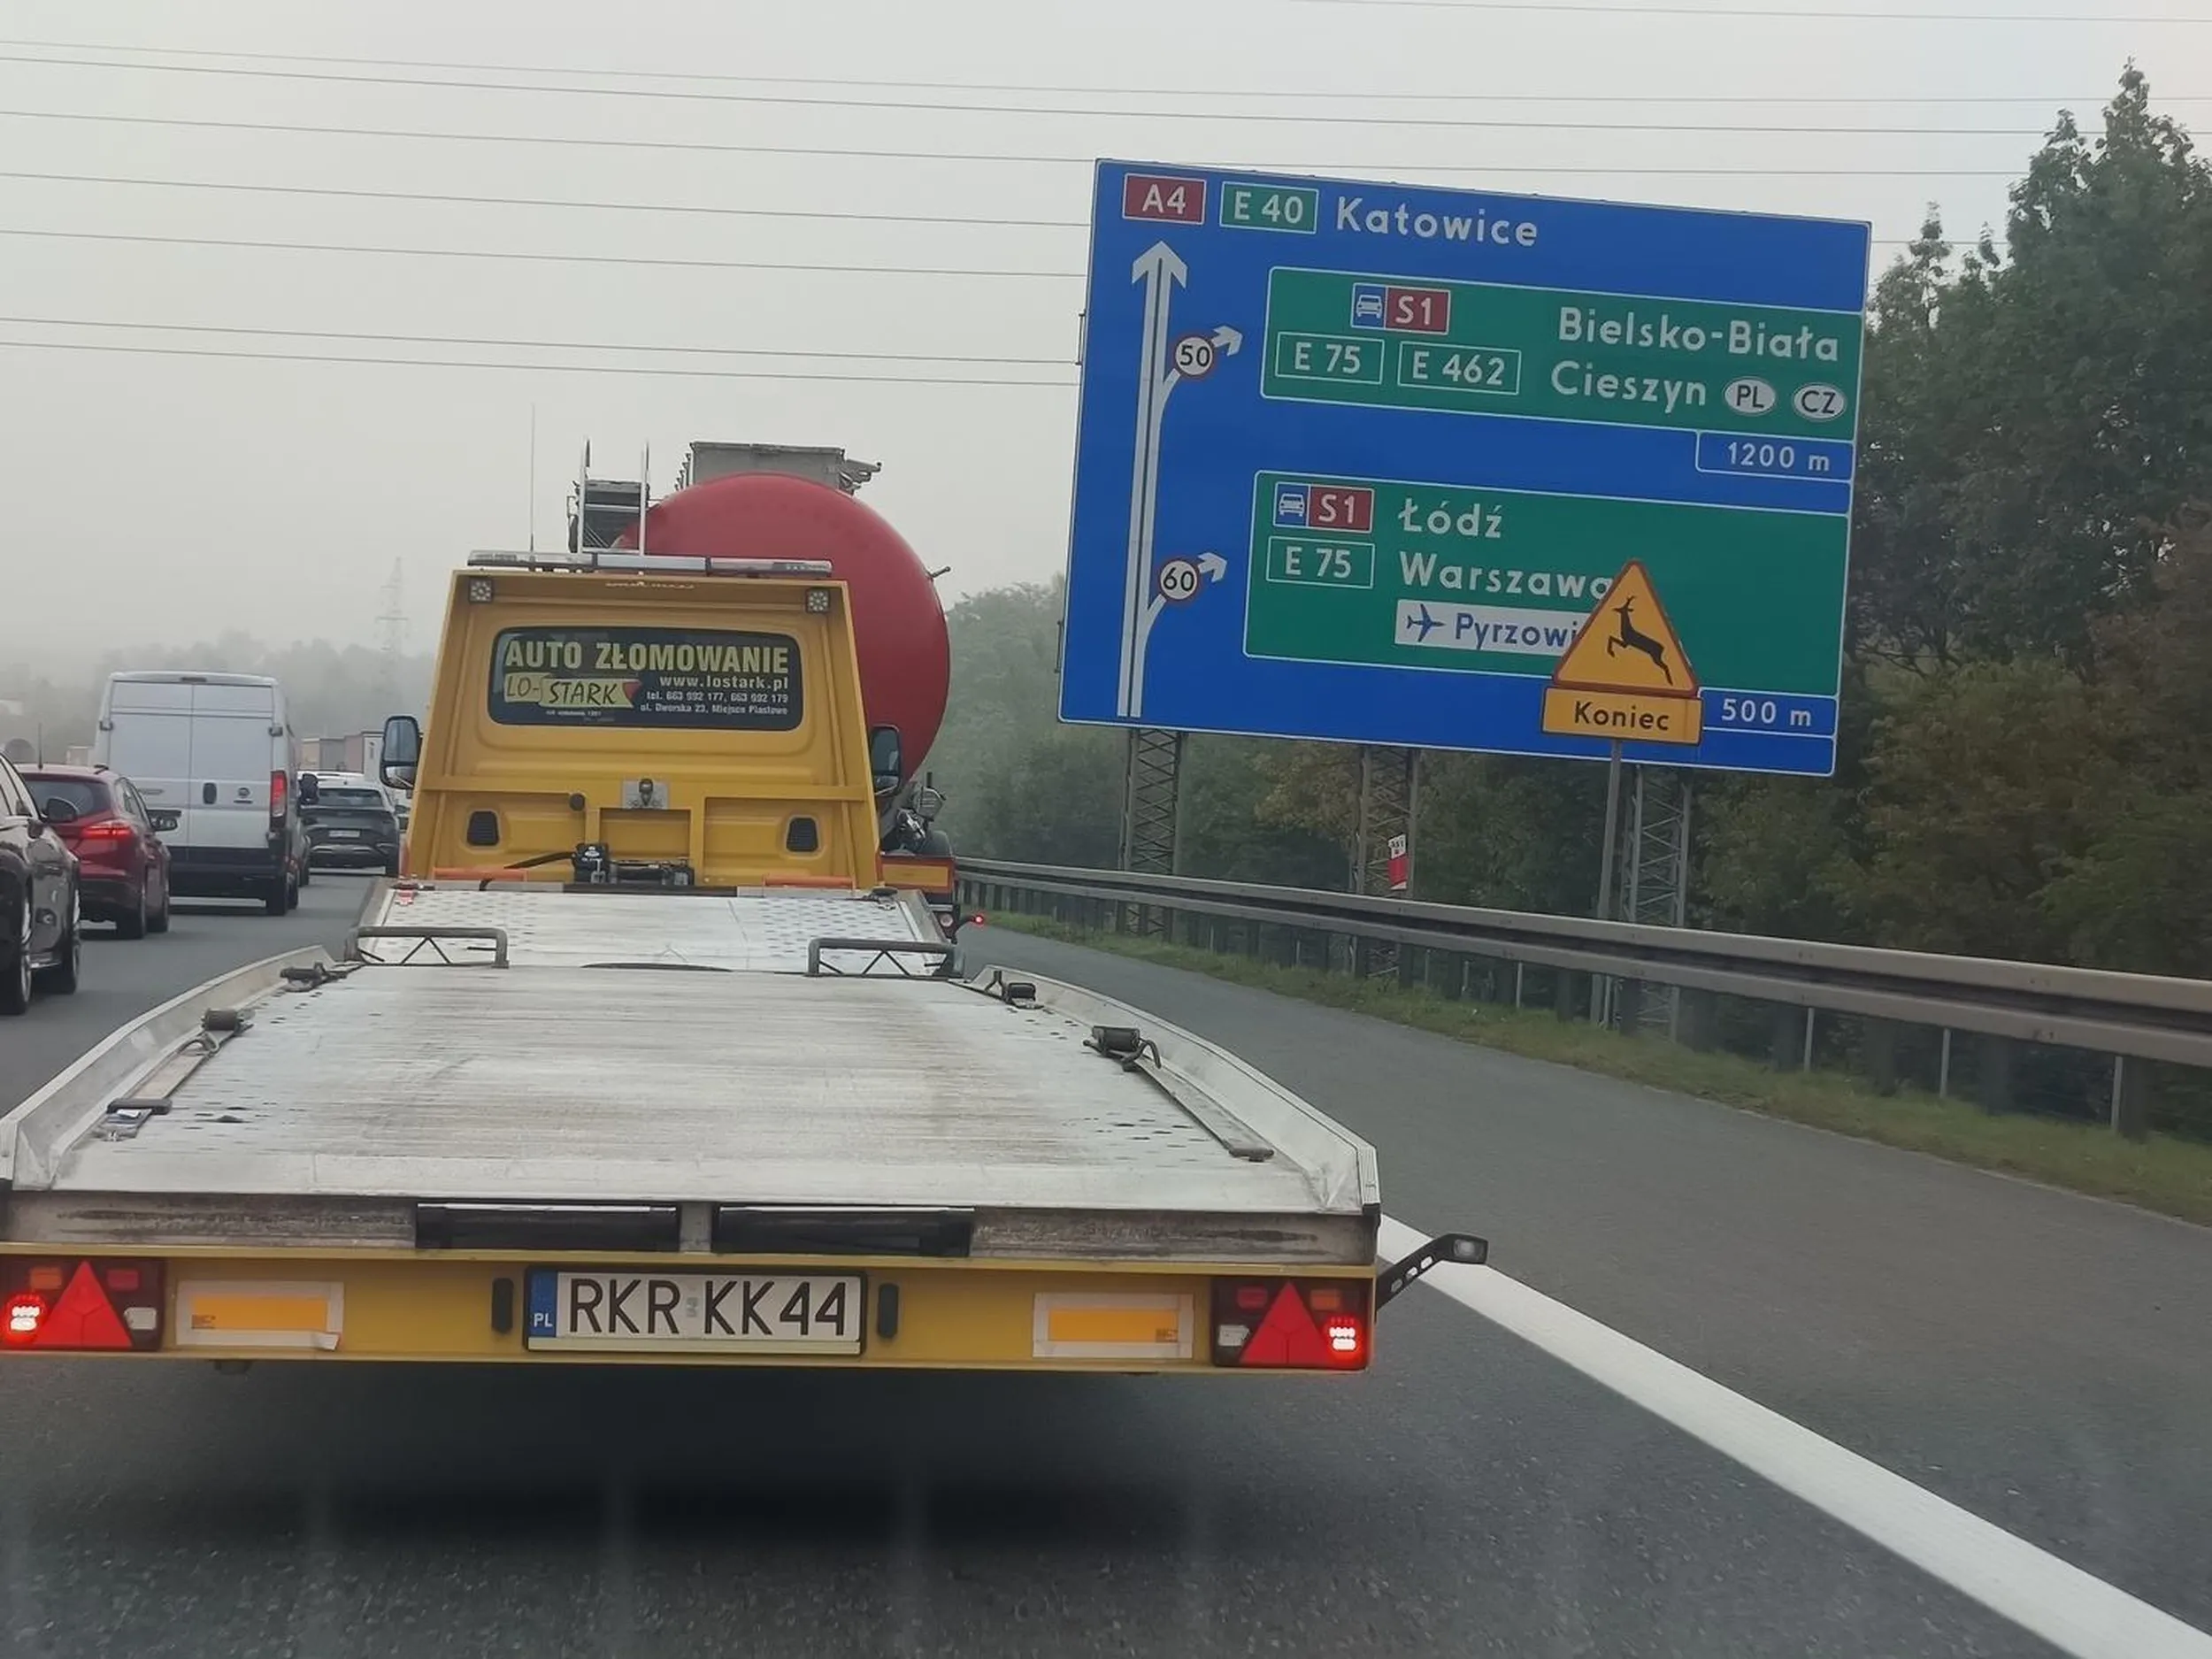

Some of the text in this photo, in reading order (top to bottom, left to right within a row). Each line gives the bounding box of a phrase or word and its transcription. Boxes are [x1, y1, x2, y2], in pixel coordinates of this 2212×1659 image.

[1141, 184, 1187, 214] A4
[1233, 191, 1304, 224] E 40
[1336, 196, 1539, 247] Katowice
[1394, 295, 1432, 326] S1
[1558, 306, 1839, 362] Bielsko-Biała
[1179, 344, 1211, 367] 50
[1294, 342, 1361, 374] E 75
[1412, 351, 1505, 386] E 462
[1550, 359, 1707, 414] Cieszyn
[1735, 384, 1765, 408] PL
[1801, 390, 1836, 414] CZ
[1728, 442, 1831, 472] 1200 m
[1317, 494, 1356, 525] S1
[1397, 498, 1503, 539] Łódź
[1285, 546, 1352, 579] E 75
[1398, 550, 1613, 600] Warszawa
[1162, 568, 1196, 591] 60
[1454, 611, 1579, 650] Pyrzowi
[505, 641, 788, 674] AUTO ZŁOMOWANIE
[659, 676, 788, 691] www.lostark.pl
[1574, 701, 1670, 731] Koniec
[1721, 698, 1811, 726] 500 m
[534, 1313, 554, 1328] PL
[570, 1279, 847, 1336] RKR KK44
